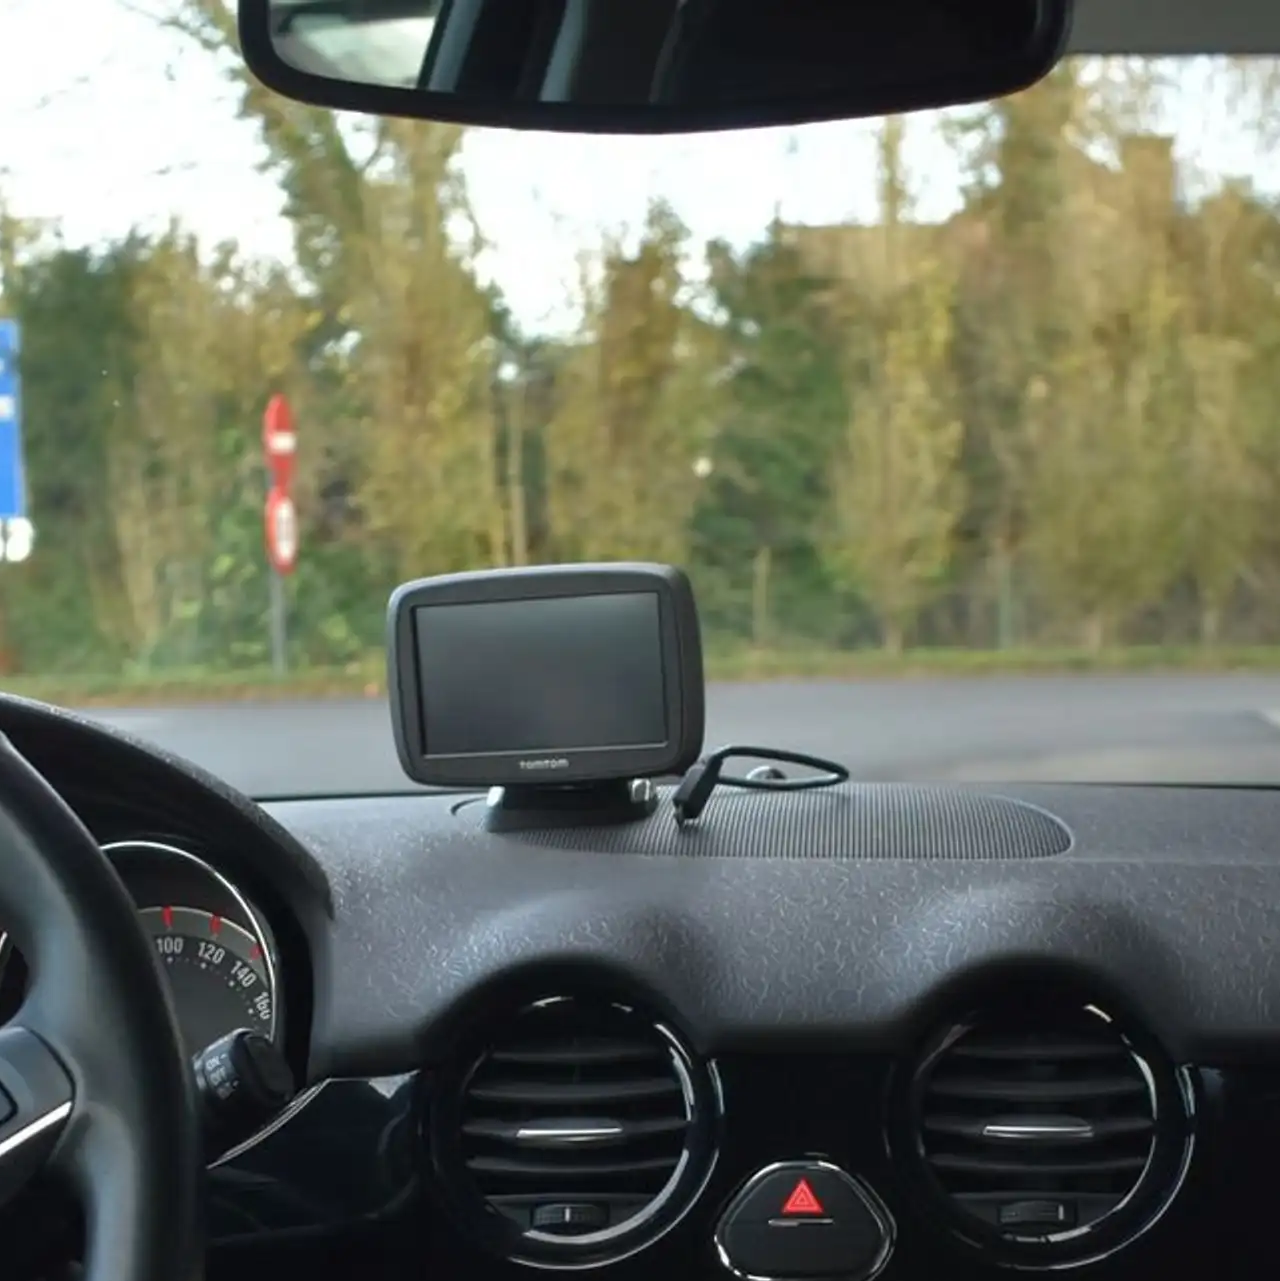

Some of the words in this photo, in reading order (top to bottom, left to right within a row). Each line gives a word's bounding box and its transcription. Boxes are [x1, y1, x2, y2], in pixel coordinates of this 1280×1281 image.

[156, 937, 184, 954] 100
[197, 942, 226, 964] 120
[230, 960, 257, 988] 140
[254, 991, 271, 1020] 160
